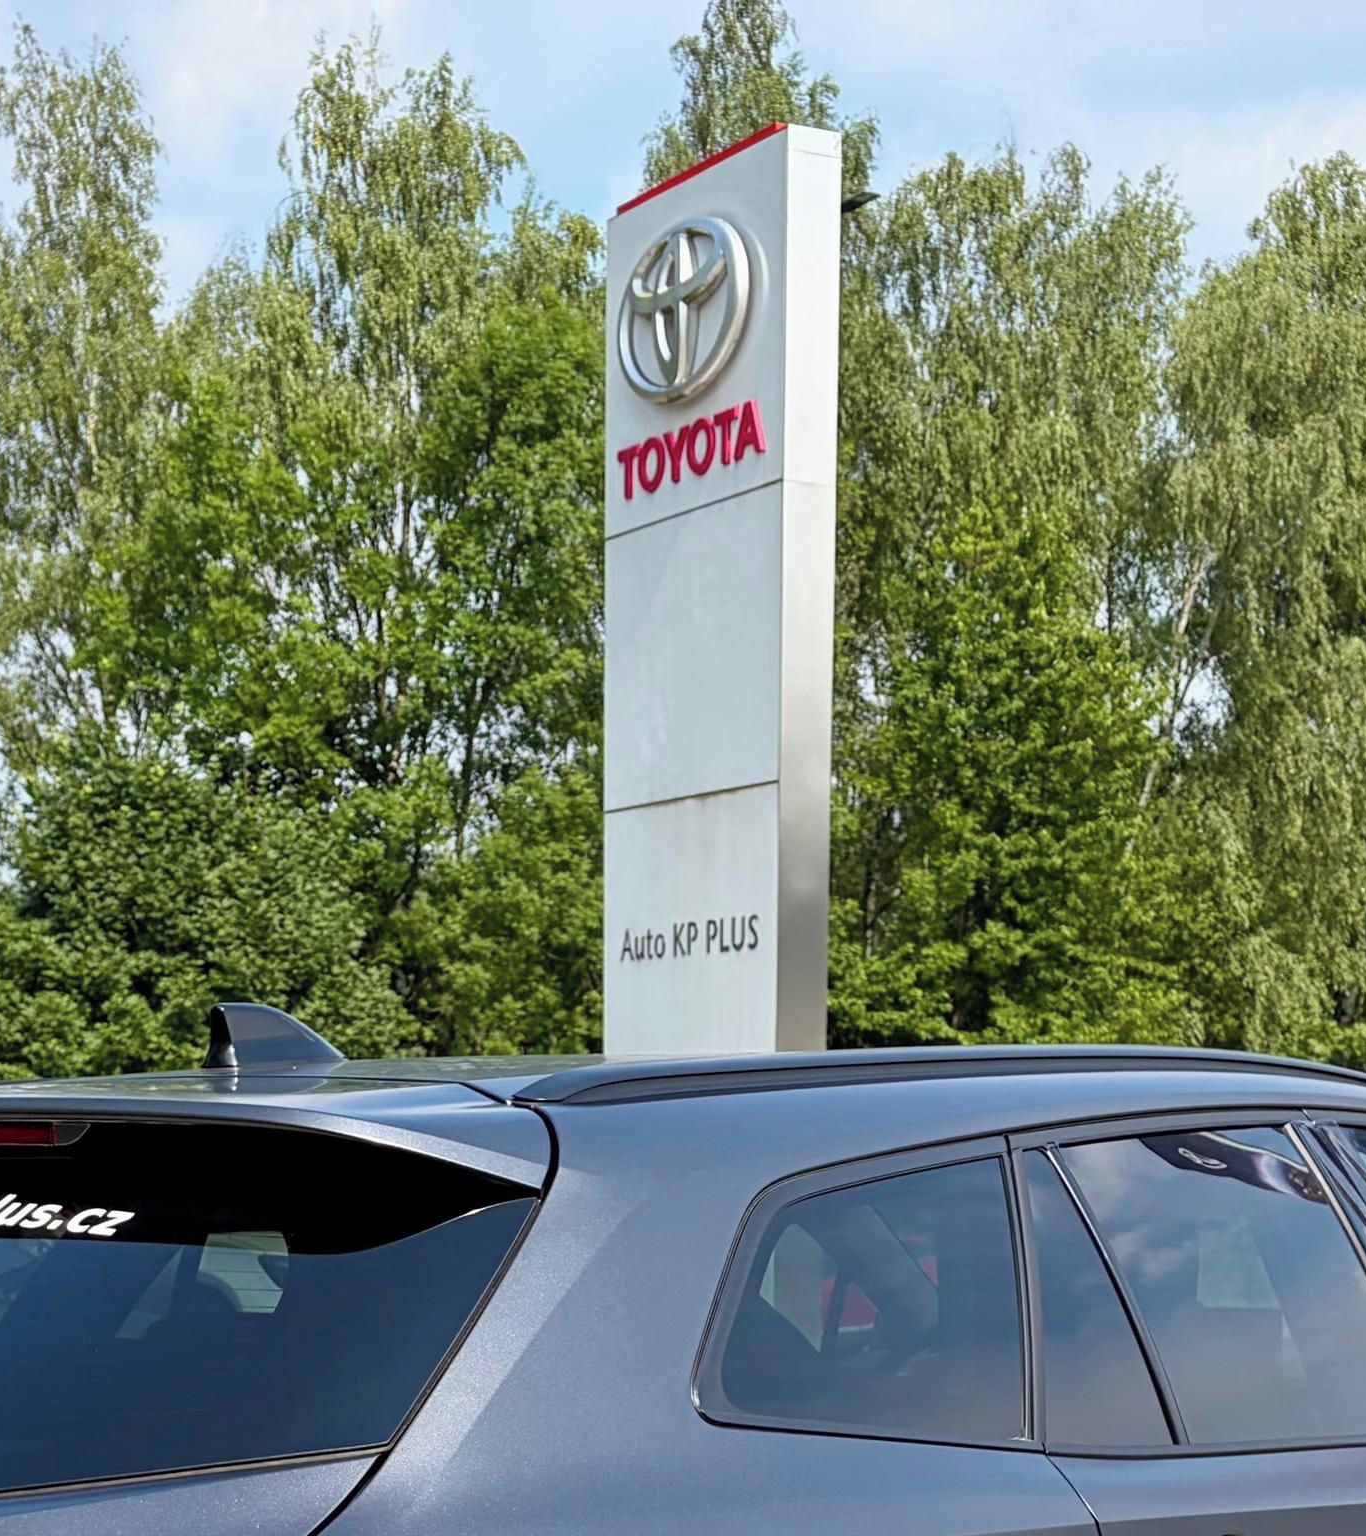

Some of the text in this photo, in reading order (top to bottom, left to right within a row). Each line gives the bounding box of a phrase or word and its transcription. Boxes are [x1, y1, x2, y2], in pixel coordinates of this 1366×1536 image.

[617, 399, 766, 500] TOYOTA
[620, 914, 759, 962] Auto KP PLUS
